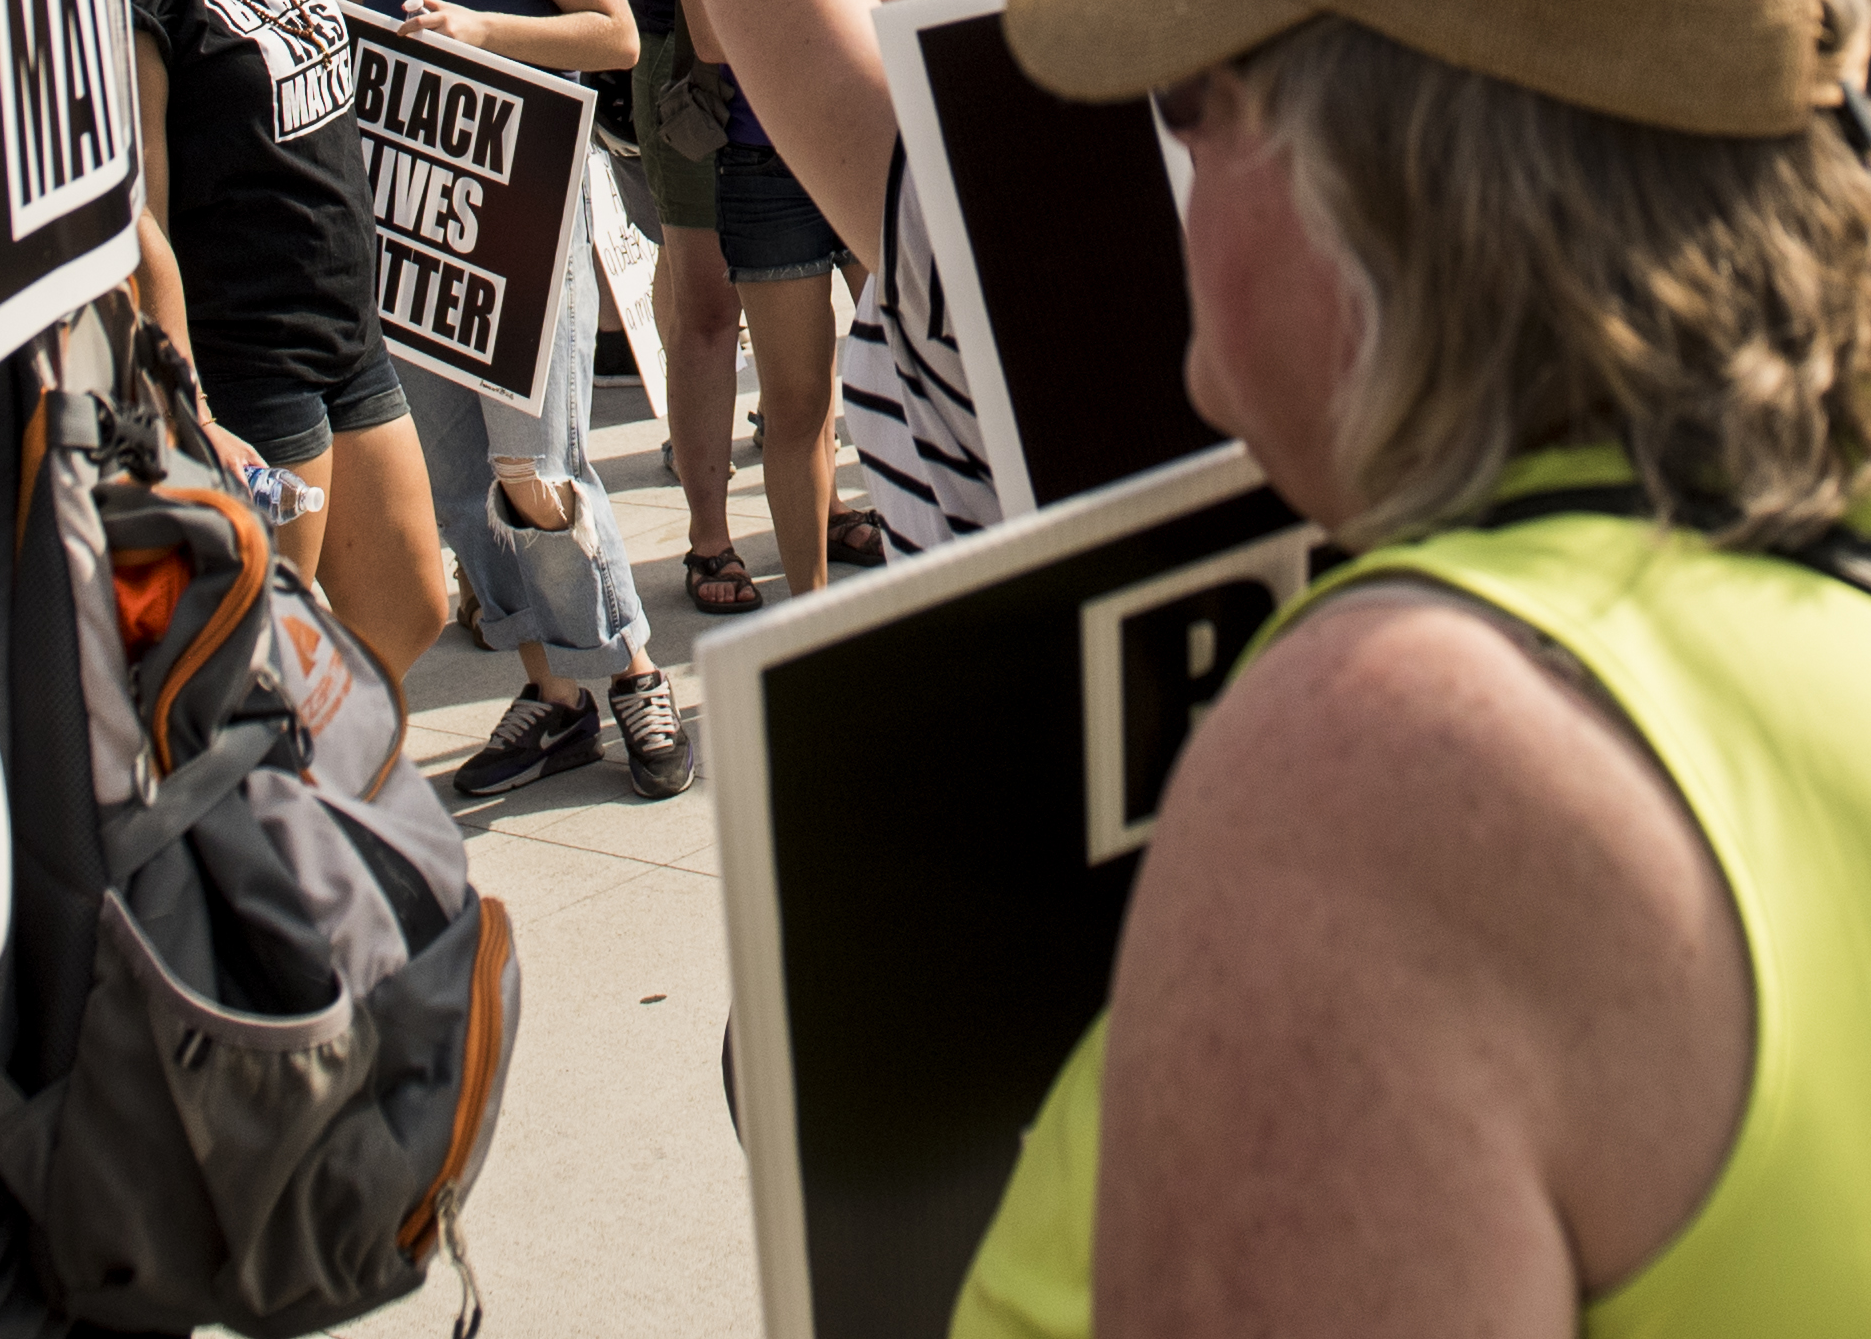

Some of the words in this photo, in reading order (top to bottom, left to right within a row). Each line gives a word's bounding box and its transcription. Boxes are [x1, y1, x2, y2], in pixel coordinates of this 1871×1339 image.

[281, 47, 353, 131] MATTE
[356, 46, 514, 174] BLACK
[363, 140, 484, 254] LIVES
